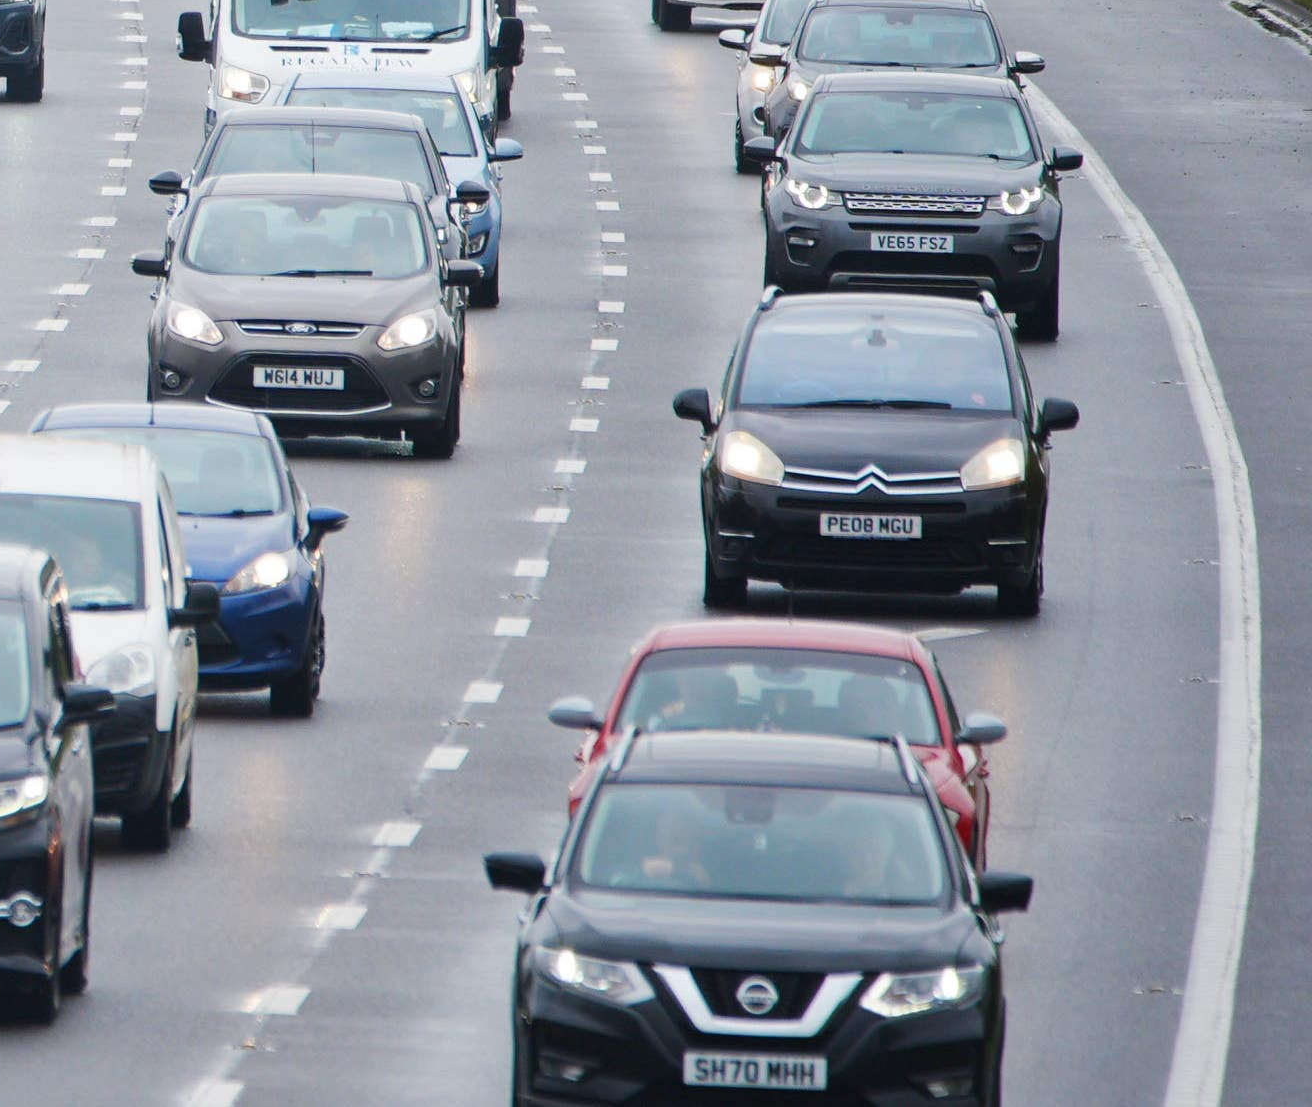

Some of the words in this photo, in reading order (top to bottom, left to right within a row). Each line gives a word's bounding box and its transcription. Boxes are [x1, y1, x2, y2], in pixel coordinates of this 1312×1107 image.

[877, 235, 915, 249] VE65
[919, 236, 948, 250] FSZ
[264, 369, 298, 384] WG14
[303, 370, 334, 385] WUJ
[827, 516, 874, 533] PE08
[878, 517, 914, 534] MGU
[695, 1058, 759, 1084] SH70
